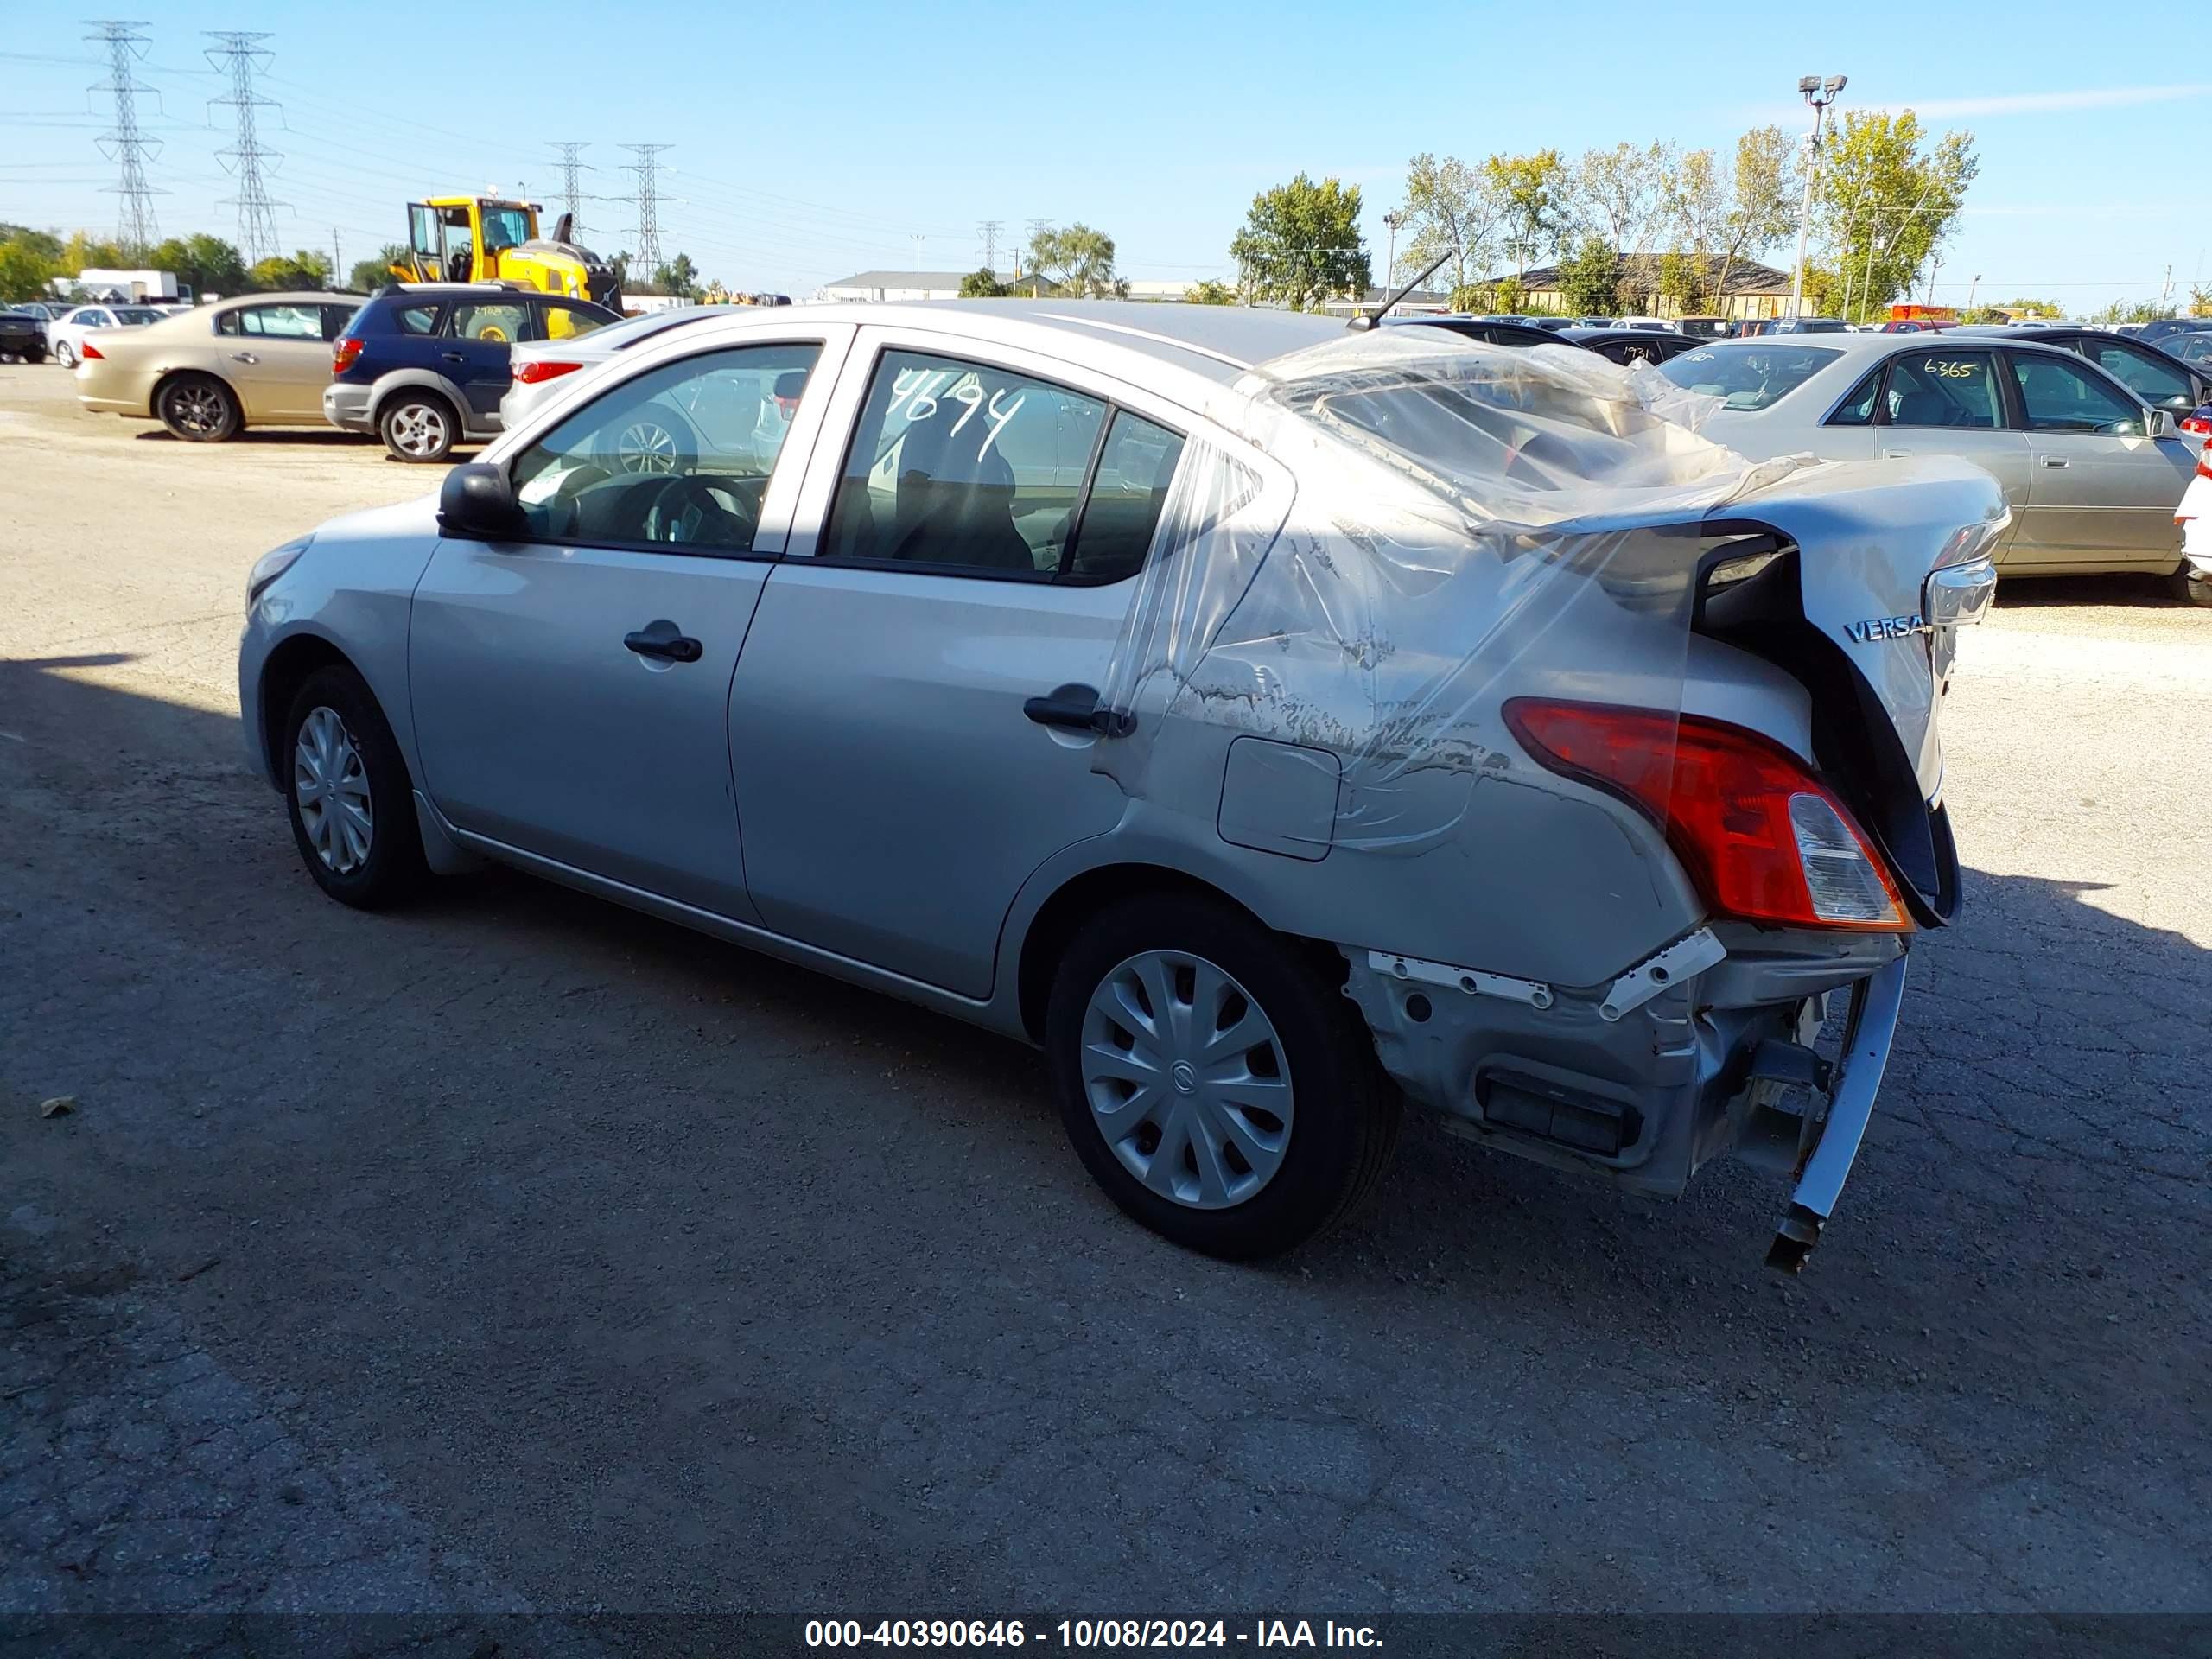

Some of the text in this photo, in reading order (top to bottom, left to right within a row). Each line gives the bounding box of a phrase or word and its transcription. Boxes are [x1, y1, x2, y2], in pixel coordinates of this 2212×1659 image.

[1624, 346, 1649, 359] 1931
[1924, 359, 1978, 378] 6365
[886, 367, 1026, 463] 4694
[1843, 614, 1924, 644] VERSA
